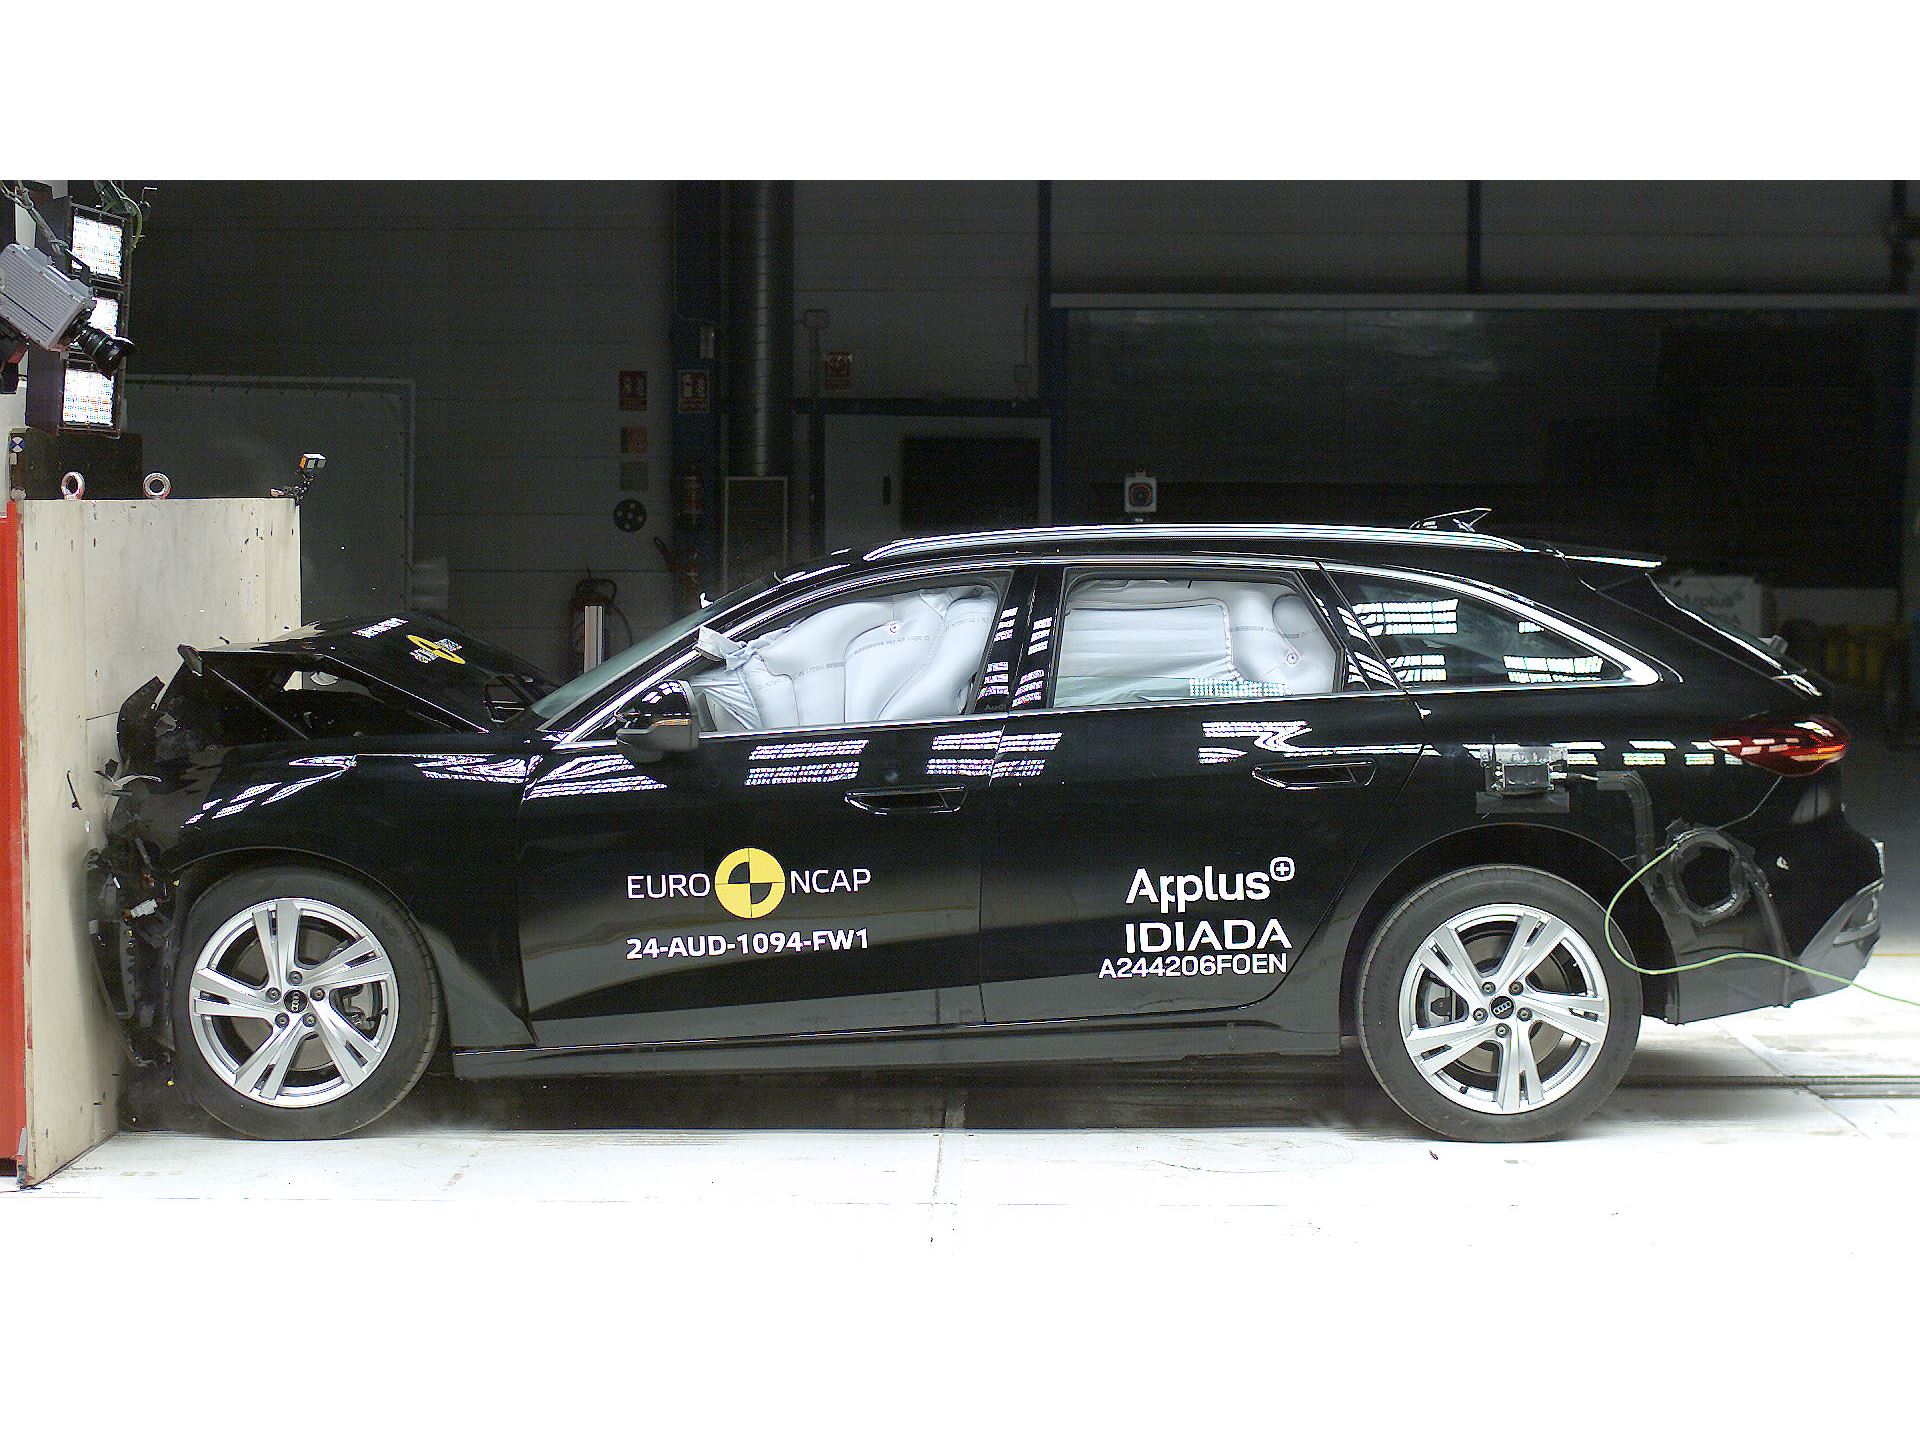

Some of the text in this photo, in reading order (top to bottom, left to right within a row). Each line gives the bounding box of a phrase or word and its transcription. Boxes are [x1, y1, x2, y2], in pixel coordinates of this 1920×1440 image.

[984, 702, 1007, 712] Audi
[627, 868, 871, 899] EURO NCAP
[626, 928, 868, 960] 24-AUD-1094-FW1
[1126, 918, 1293, 954] IDIADA
